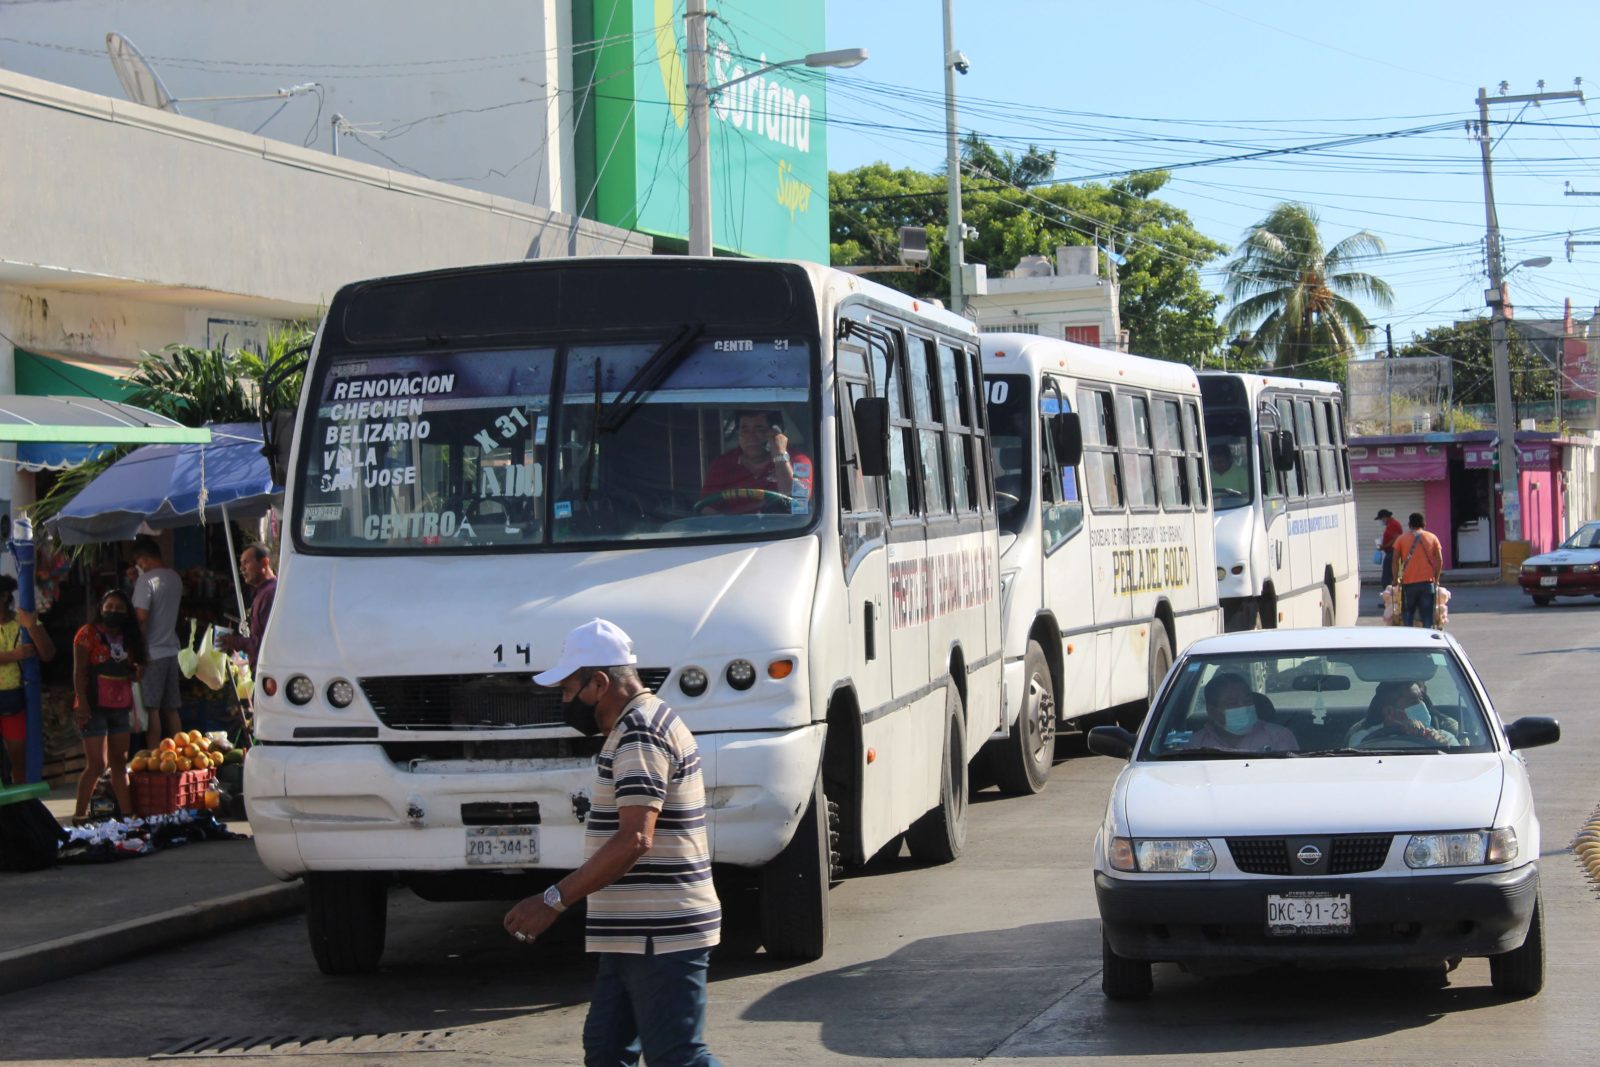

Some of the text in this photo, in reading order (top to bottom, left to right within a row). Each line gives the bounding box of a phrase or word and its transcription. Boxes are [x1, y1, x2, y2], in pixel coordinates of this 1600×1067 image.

[715, 40, 811, 153] Soriana
[334, 374, 455, 400] RENOVACION
[330, 398, 424, 421] CHECHEN
[325, 420, 431, 445] BELIZARIO
[473, 407, 529, 454] X 31
[320, 466, 417, 493] SAN JOSE
[363, 511, 456, 541] CENTRO
[1112, 546, 1190, 594] PERLA DEL GOLFO
[469, 839, 537, 856] 203-344-B
[1269, 902, 1348, 921] DKC-91-23
